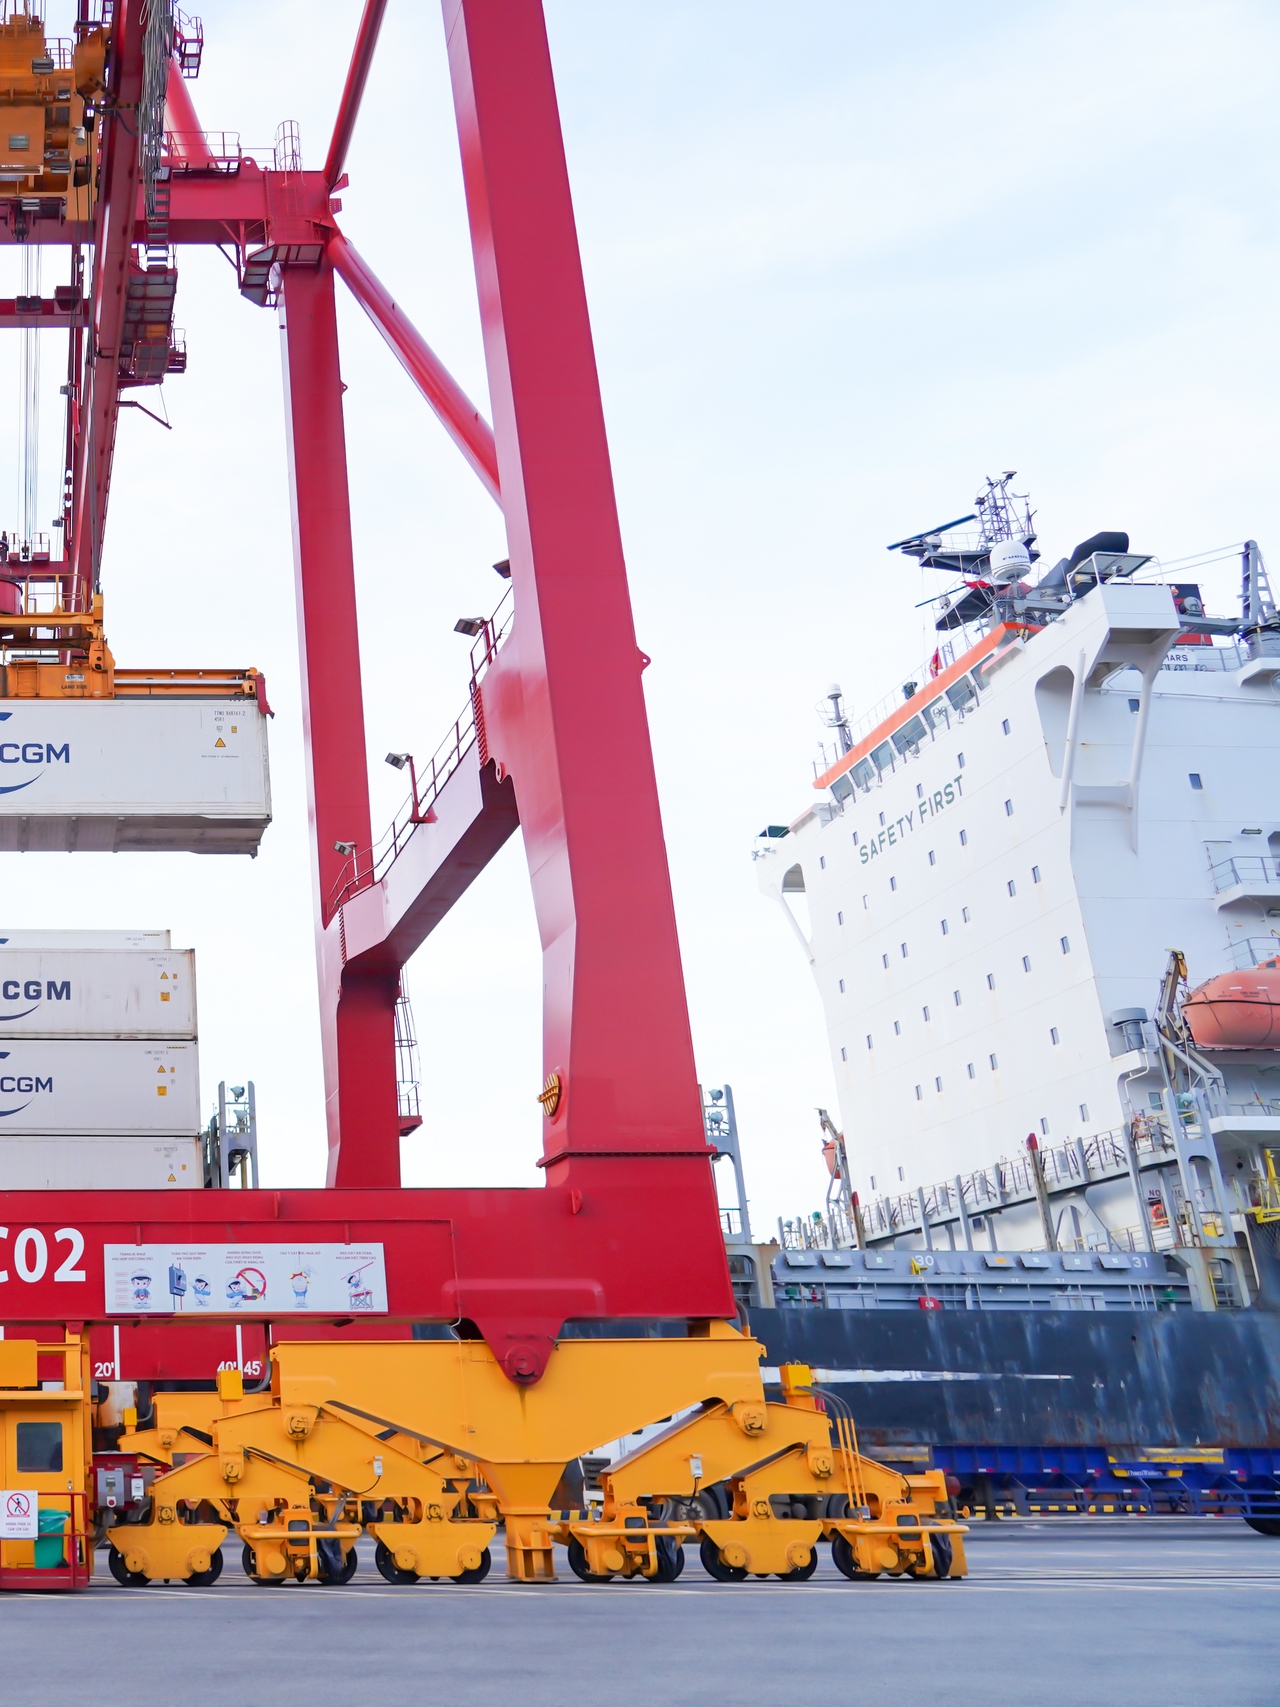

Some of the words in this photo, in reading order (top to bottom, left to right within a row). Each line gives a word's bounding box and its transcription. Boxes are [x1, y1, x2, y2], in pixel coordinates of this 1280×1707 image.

[859, 810, 913, 865] SAFETY
[918, 774, 963, 824] FIRST
[2, 979, 71, 1001] CGM
[0, 1076, 53, 1093] CGM
[1132, 1256, 1149, 1268] 31
[95, 1362, 115, 1377] 20'
